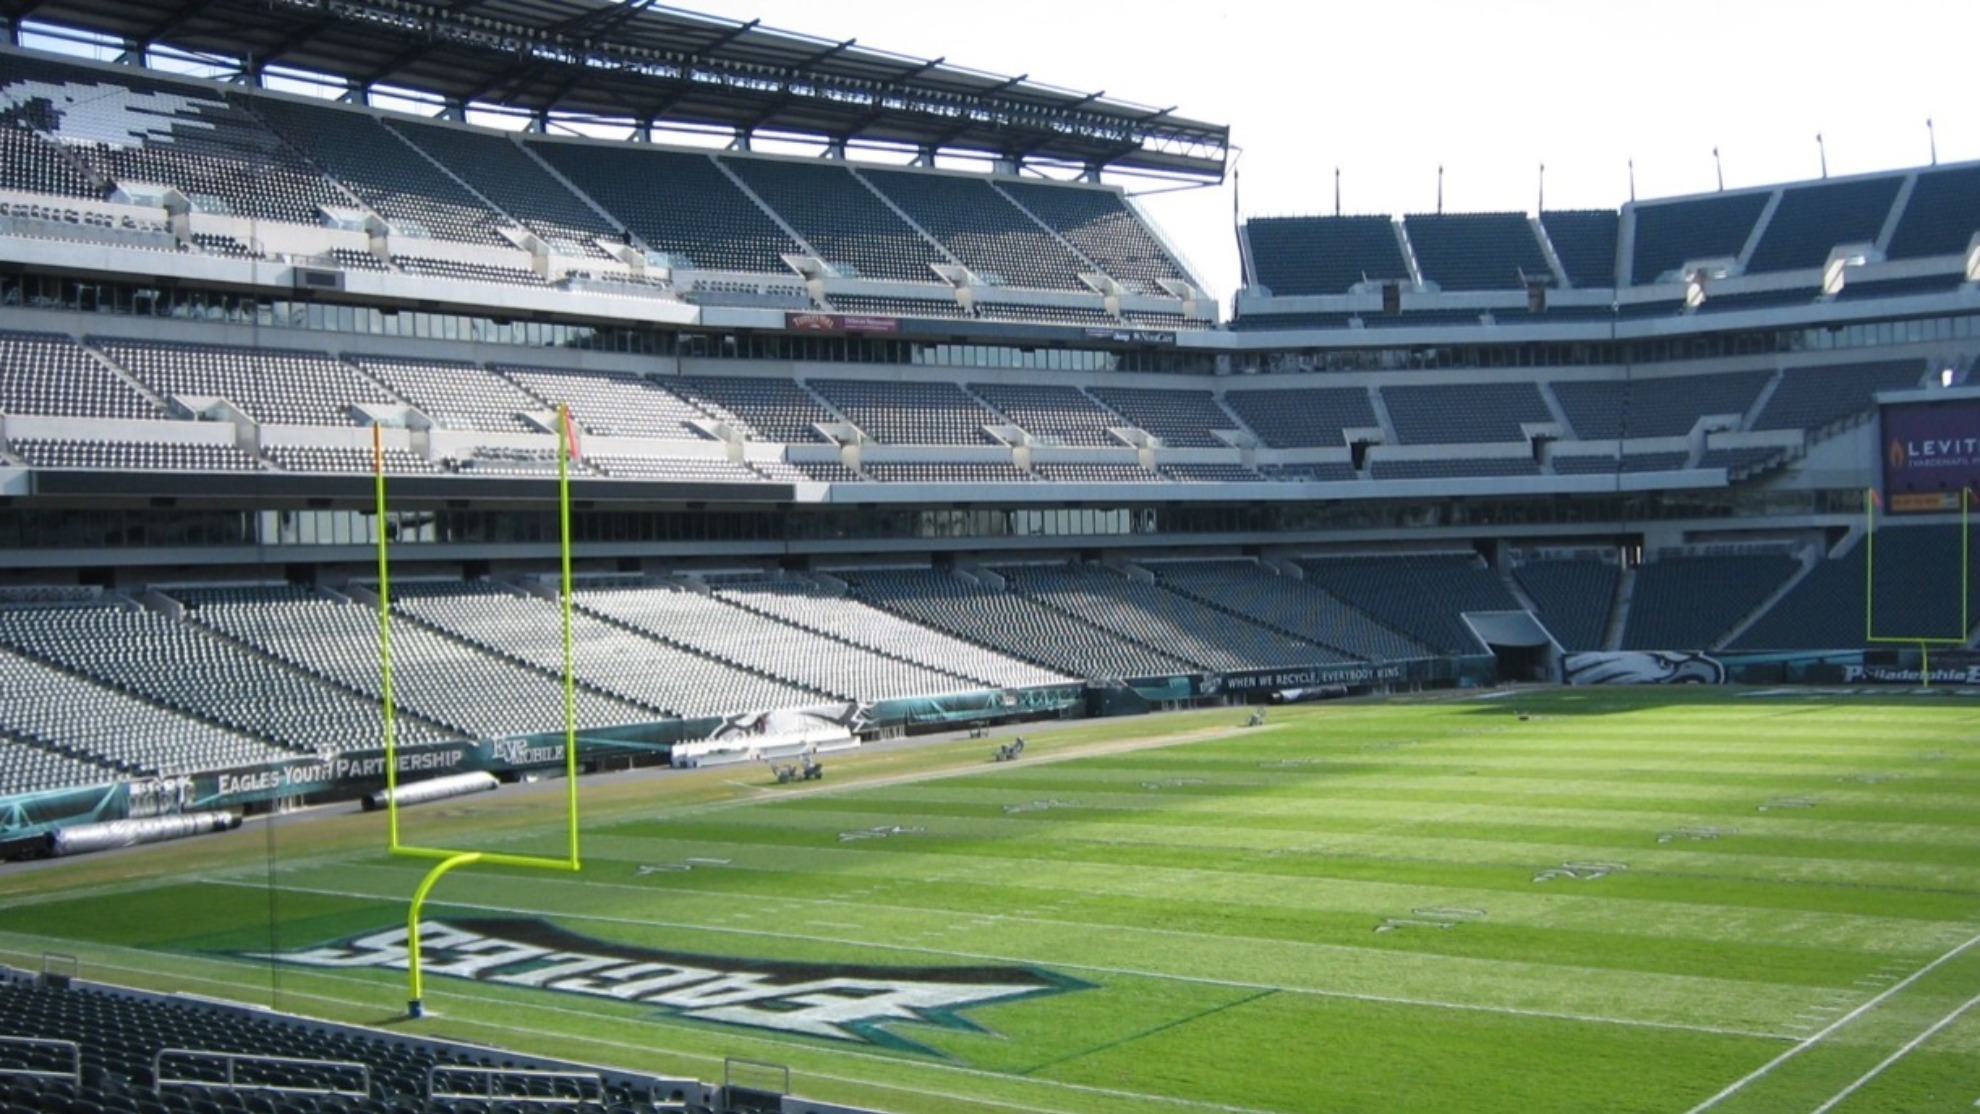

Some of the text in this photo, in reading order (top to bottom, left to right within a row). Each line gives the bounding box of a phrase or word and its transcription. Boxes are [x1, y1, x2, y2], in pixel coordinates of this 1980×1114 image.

[1908, 438, 1980, 456] LEVIT
[1228, 666, 1399, 688] WHEN WE RECYCLE, EVERYBODY WINS
[218, 770, 280, 794] EAGLES
